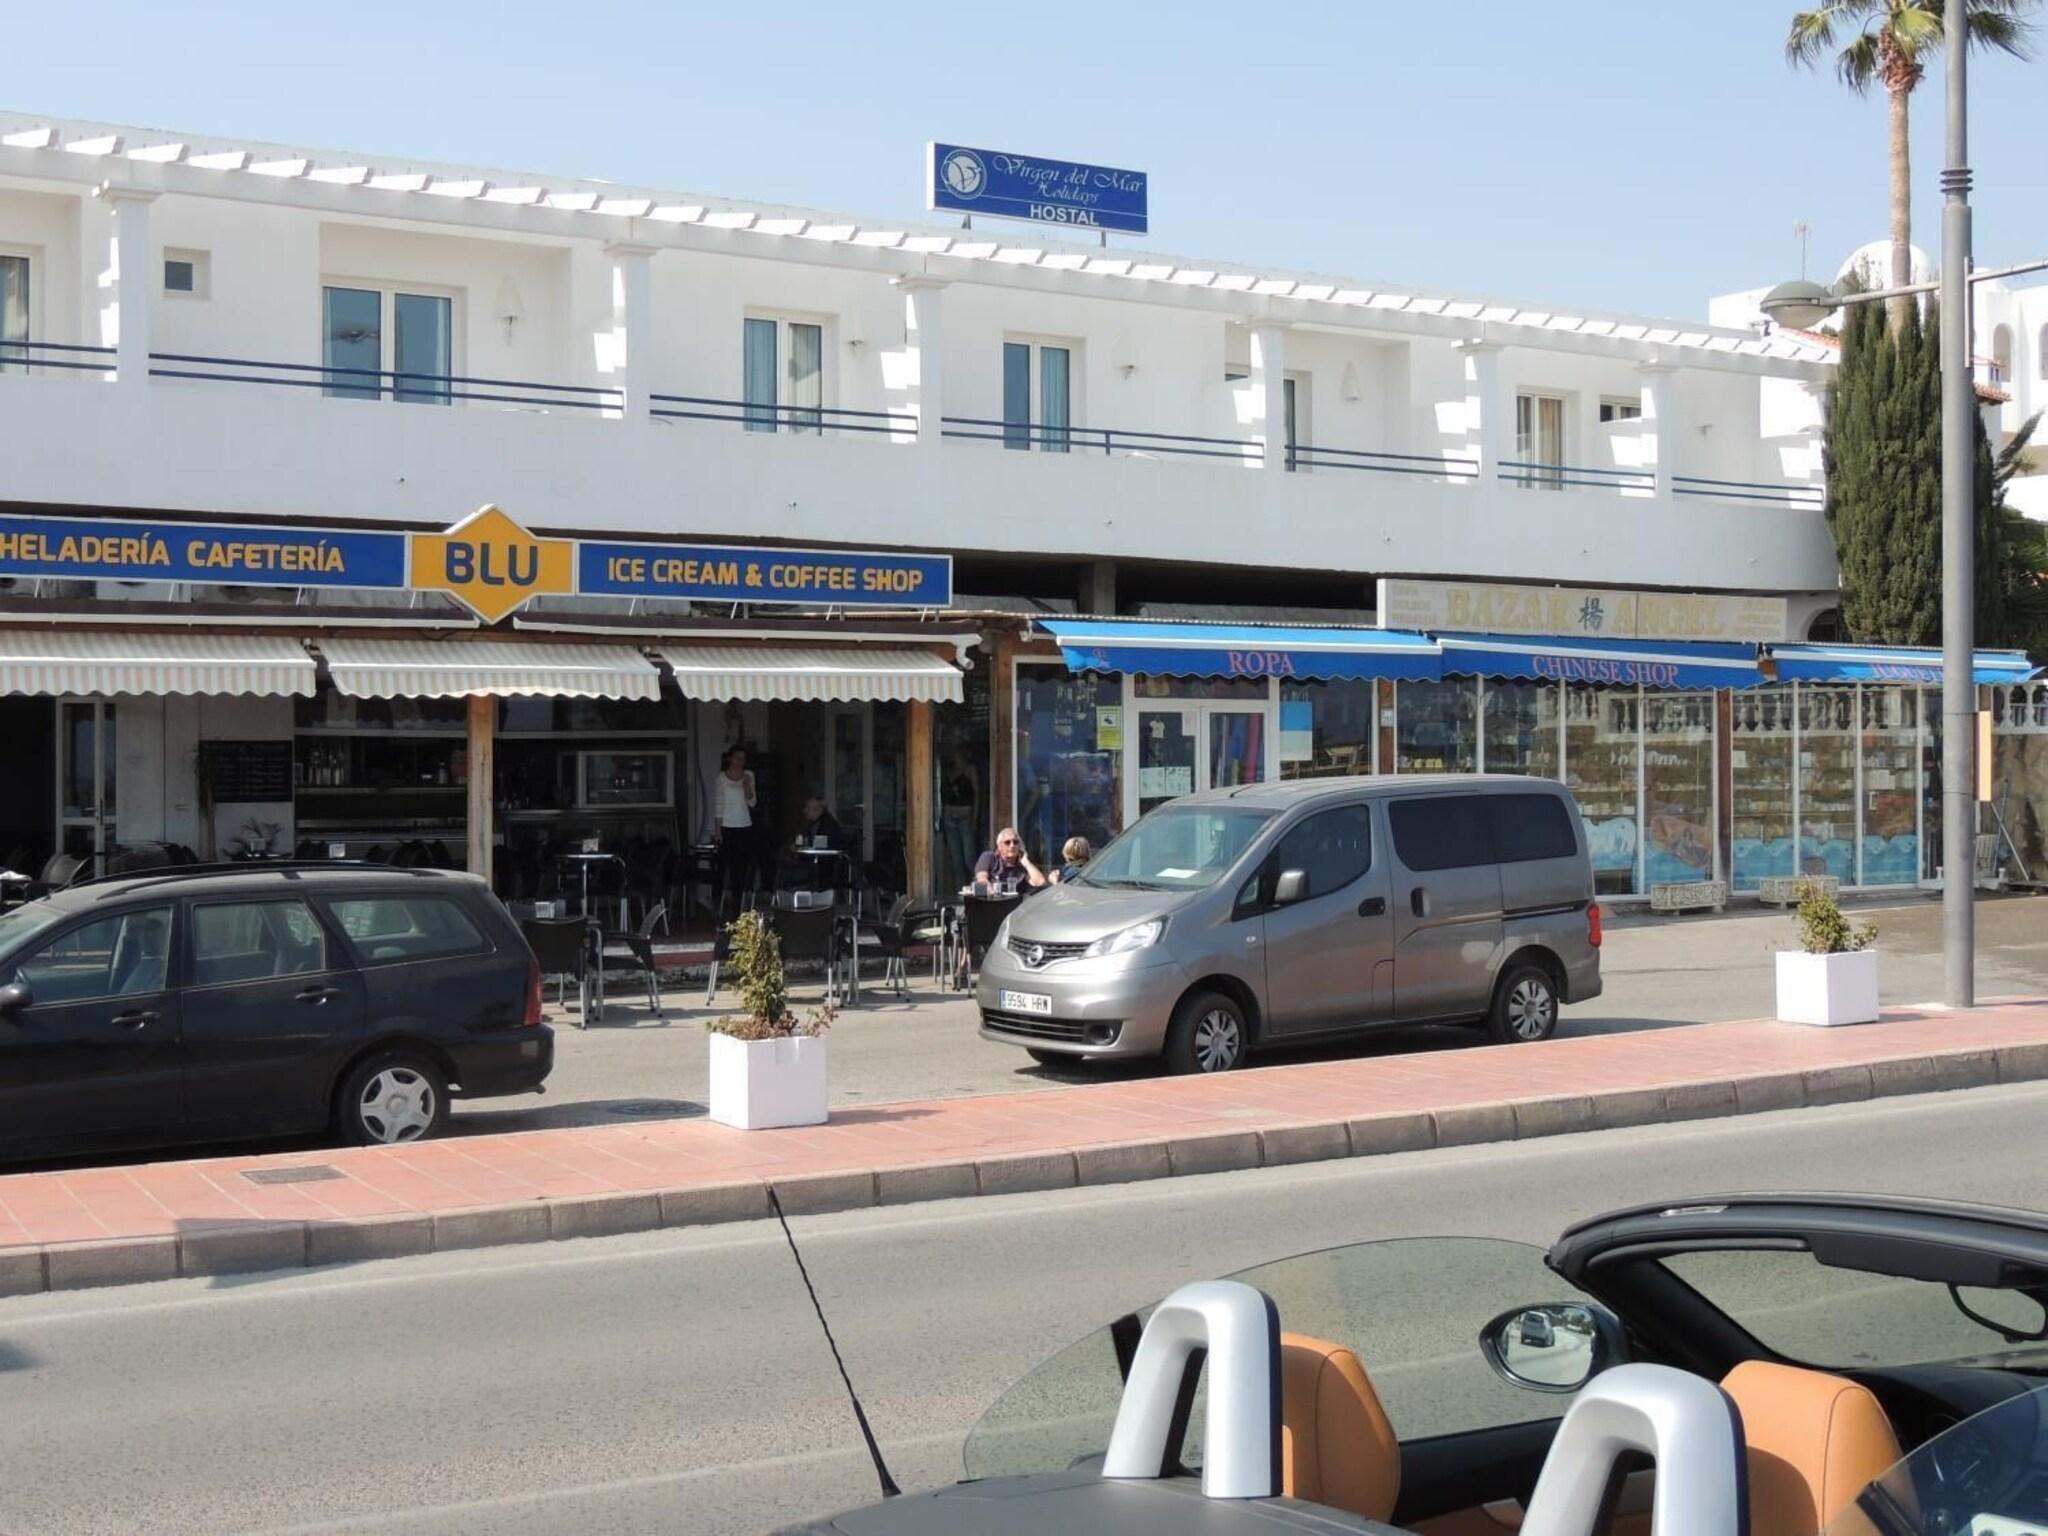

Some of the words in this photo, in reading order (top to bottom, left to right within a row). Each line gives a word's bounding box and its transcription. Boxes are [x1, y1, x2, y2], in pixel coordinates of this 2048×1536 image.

[992, 154, 1060, 184] Virgen
[1064, 167, 1089, 185] del
[1093, 172, 1144, 192] Mar
[1030, 204, 1099, 226] HOSTAL
[0, 533, 170, 566] HELADERÍA
[187, 539, 345, 573] CAFETERÍA
[445, 541, 538, 586] BLU
[608, 557, 645, 582] ICE
[652, 558, 739, 586] CREAM
[745, 562, 763, 588] &
[769, 565, 856, 591] COFFEE
[863, 568, 924, 592] SHOP
[1446, 588, 1571, 632] BAZAR
[1228, 651, 1297, 674] ROPA
[1532, 655, 1621, 681] CHINESE
[1626, 661, 1679, 684] SHOP
